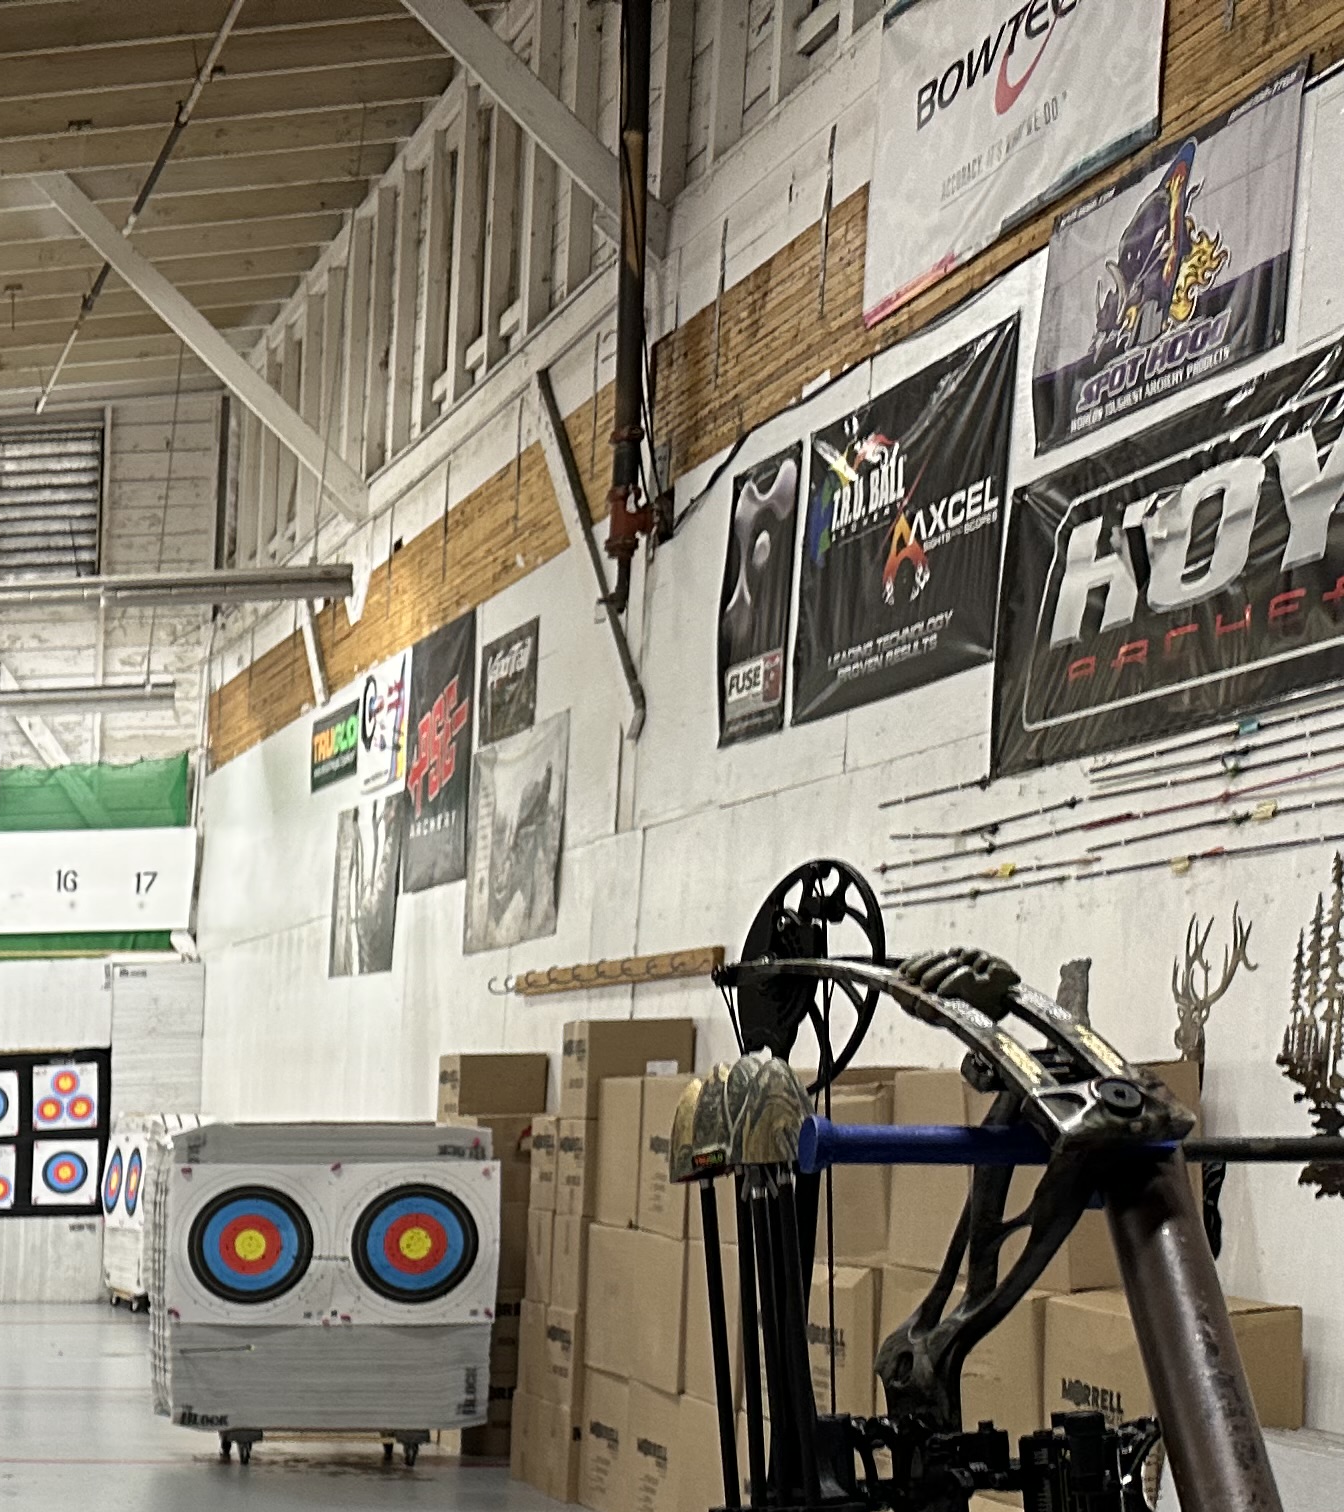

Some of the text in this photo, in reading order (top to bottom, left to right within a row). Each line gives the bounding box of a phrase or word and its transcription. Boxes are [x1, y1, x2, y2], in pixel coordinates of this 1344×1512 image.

[869, 445, 906, 509] BALL
[908, 474, 998, 546] AXCEL
[728, 665, 762, 697] FUSE
[56, 868, 79, 893] 16
[135, 870, 159, 895] 17
